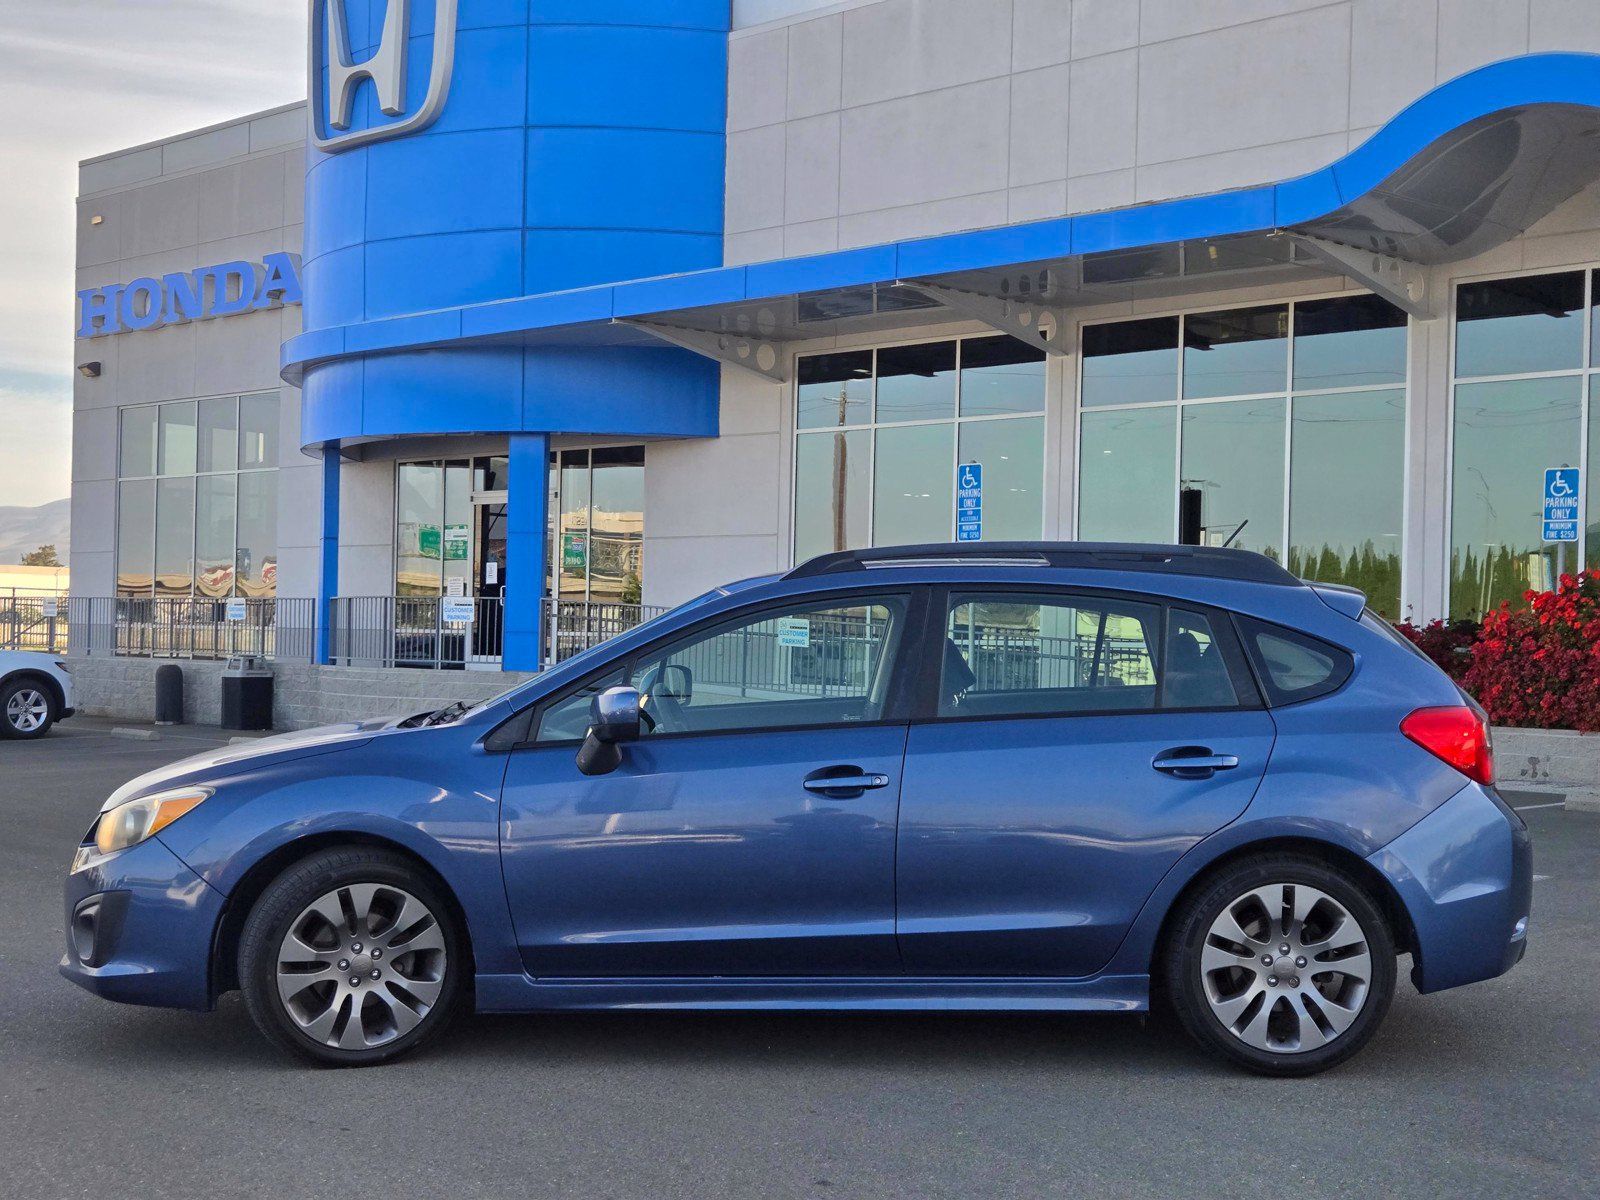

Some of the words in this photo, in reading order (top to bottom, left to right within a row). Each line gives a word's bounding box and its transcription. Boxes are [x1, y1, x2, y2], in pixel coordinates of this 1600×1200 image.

[77, 251, 303, 339] HONDA
[960, 489, 981, 498] PARKING
[963, 499, 977, 508] ONLY
[1545, 497, 1578, 508] PARKING
[1551, 509, 1571, 519] ONLY
[1549, 522, 1572, 530] MINIMUM
[1546, 531, 1558, 539] FINE
[1561, 531, 1575, 539] $250
